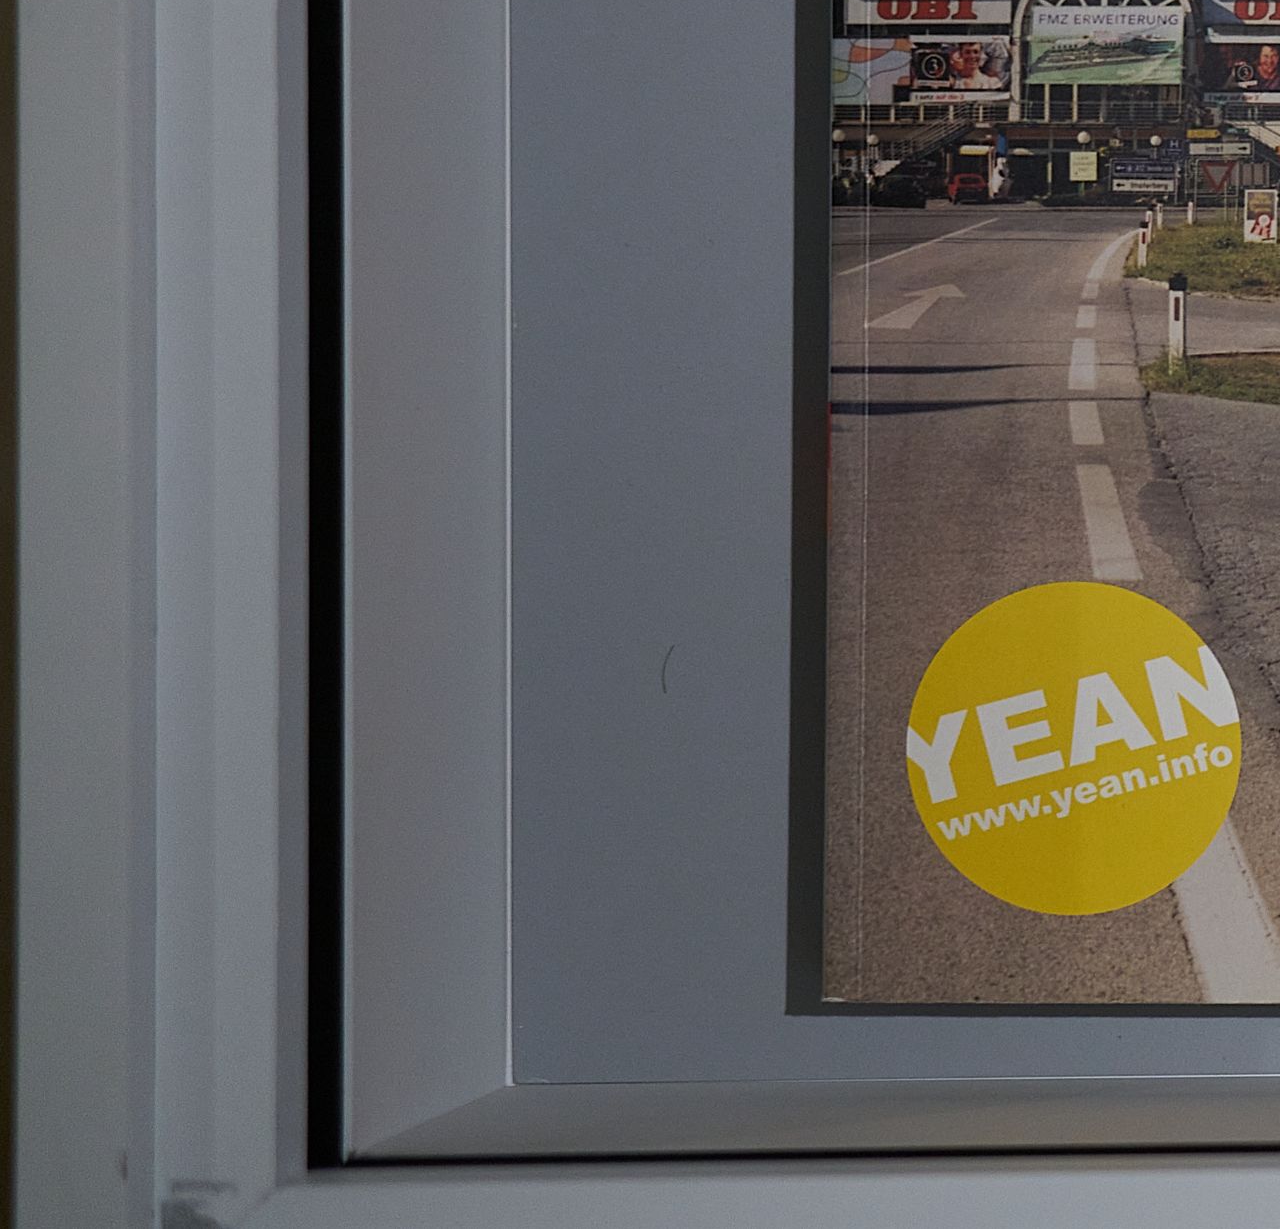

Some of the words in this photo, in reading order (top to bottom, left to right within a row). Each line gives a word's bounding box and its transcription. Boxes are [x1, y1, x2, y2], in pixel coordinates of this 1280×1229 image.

[1038, 13, 1069, 26] FMZ
[1073, 13, 1180, 26] ERWEITERUNG
[905, 644, 1241, 805] YEAN
[935, 741, 1234, 842] www.yean.info
